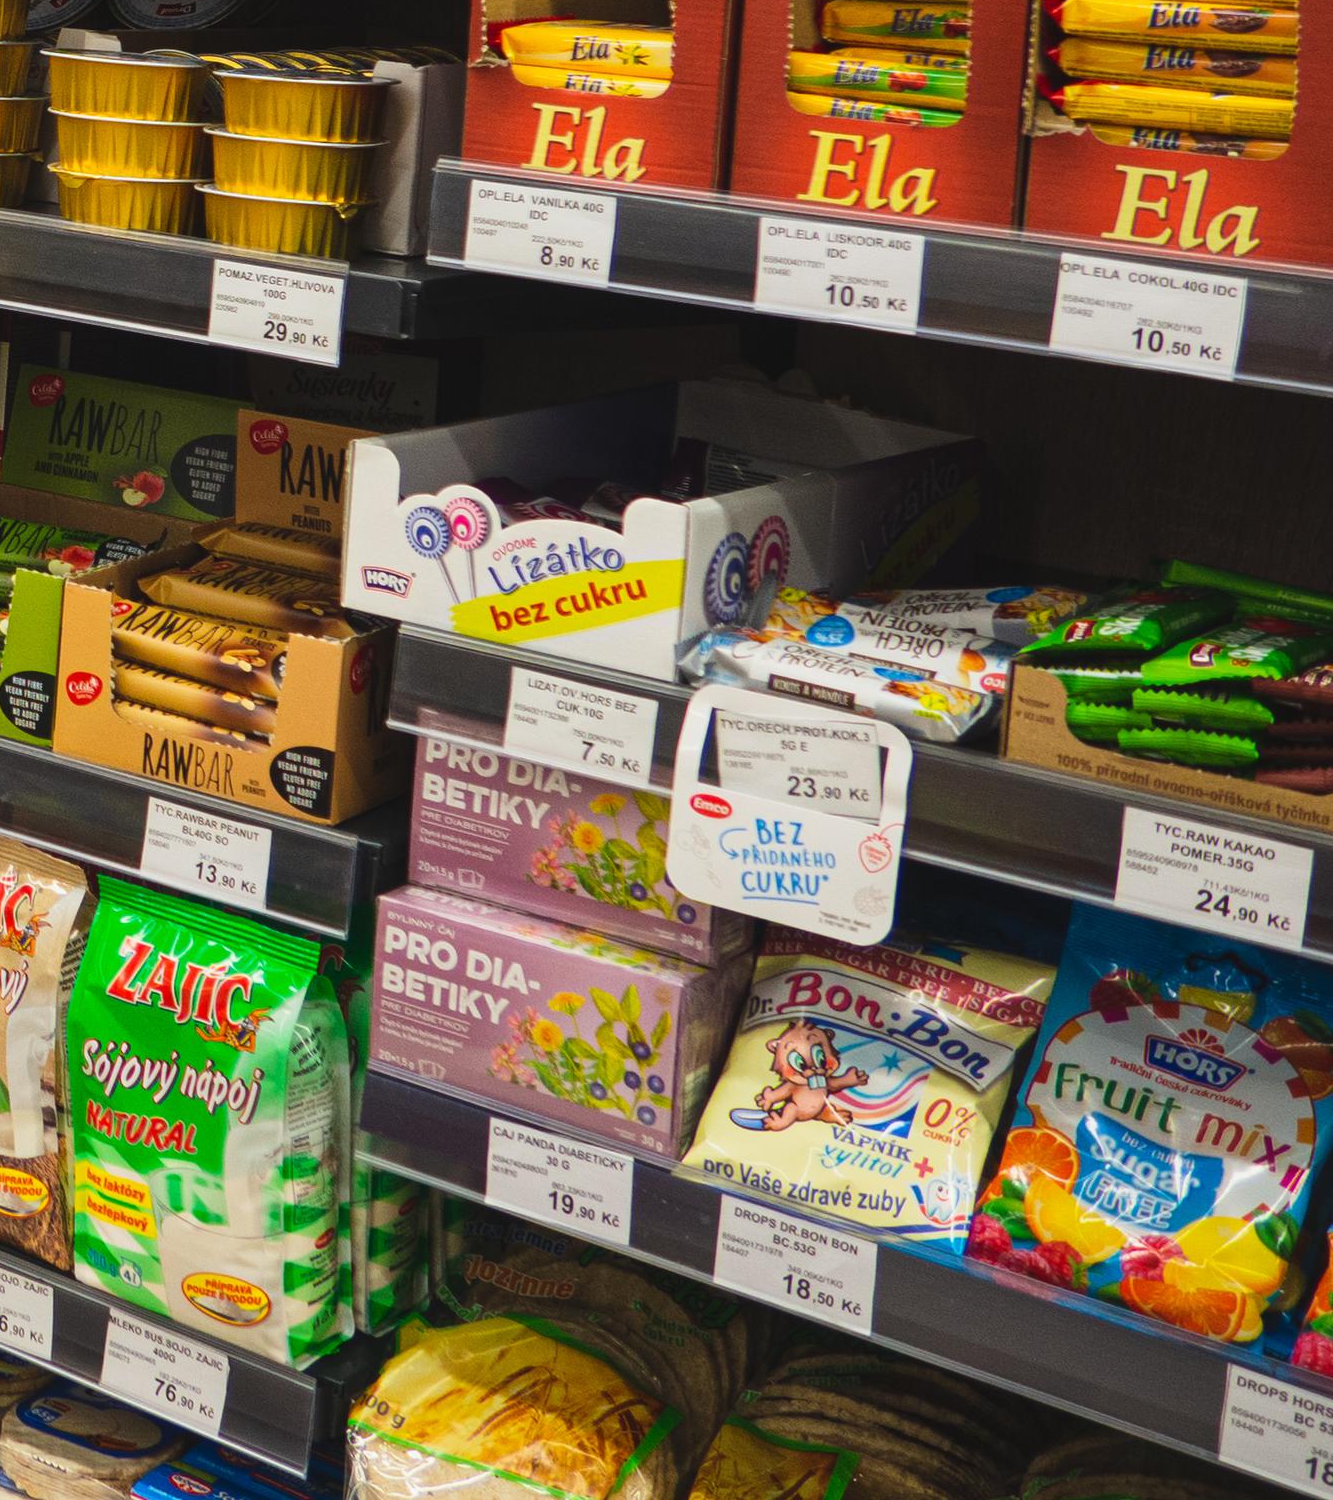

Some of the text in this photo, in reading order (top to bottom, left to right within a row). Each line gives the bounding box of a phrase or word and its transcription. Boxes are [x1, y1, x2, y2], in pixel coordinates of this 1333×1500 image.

[521, 101, 649, 182] Ela
[796, 129, 938, 216] Ela
[1101, 164, 1261, 257] Ela
[1060, 261, 1121, 280] OPL.ELA
[1211, 285, 1237, 297] IDC
[262, 319, 328, 348] 29,90 Kč
[1132, 328, 1222, 360] 10,50 Kč
[365, 568, 410, 594] HORS
[489, 537, 624, 593] Lízátko
[491, 575, 647, 632] bez cukru
[143, 733, 234, 796] RAWBAR
[787, 776, 869, 802] 23,90 Kč
[756, 819, 803, 844] BEZ
[1171, 844, 1254, 872] POMER.35G
[1224, 839, 1276, 861] KAKAO
[1196, 890, 1291, 930] 24,90 Kč
[383, 927, 459, 971] PRO
[106, 938, 253, 1029] ZAJÍC
[382, 969, 509, 1024] BETIKY
[745, 972, 988, 1078] Dr. Bon Bon
[81, 1039, 263, 1123] Sójový nápoj
[1153, 1041, 1239, 1086] HORS
[87, 1100, 199, 1154] NATURAL
[1055, 1063, 1291, 1173] Fruit mix
[548, 1190, 620, 1227] 19,90 Kč
[703, 1157, 907, 1218] pro Vaše zdravé zuby
